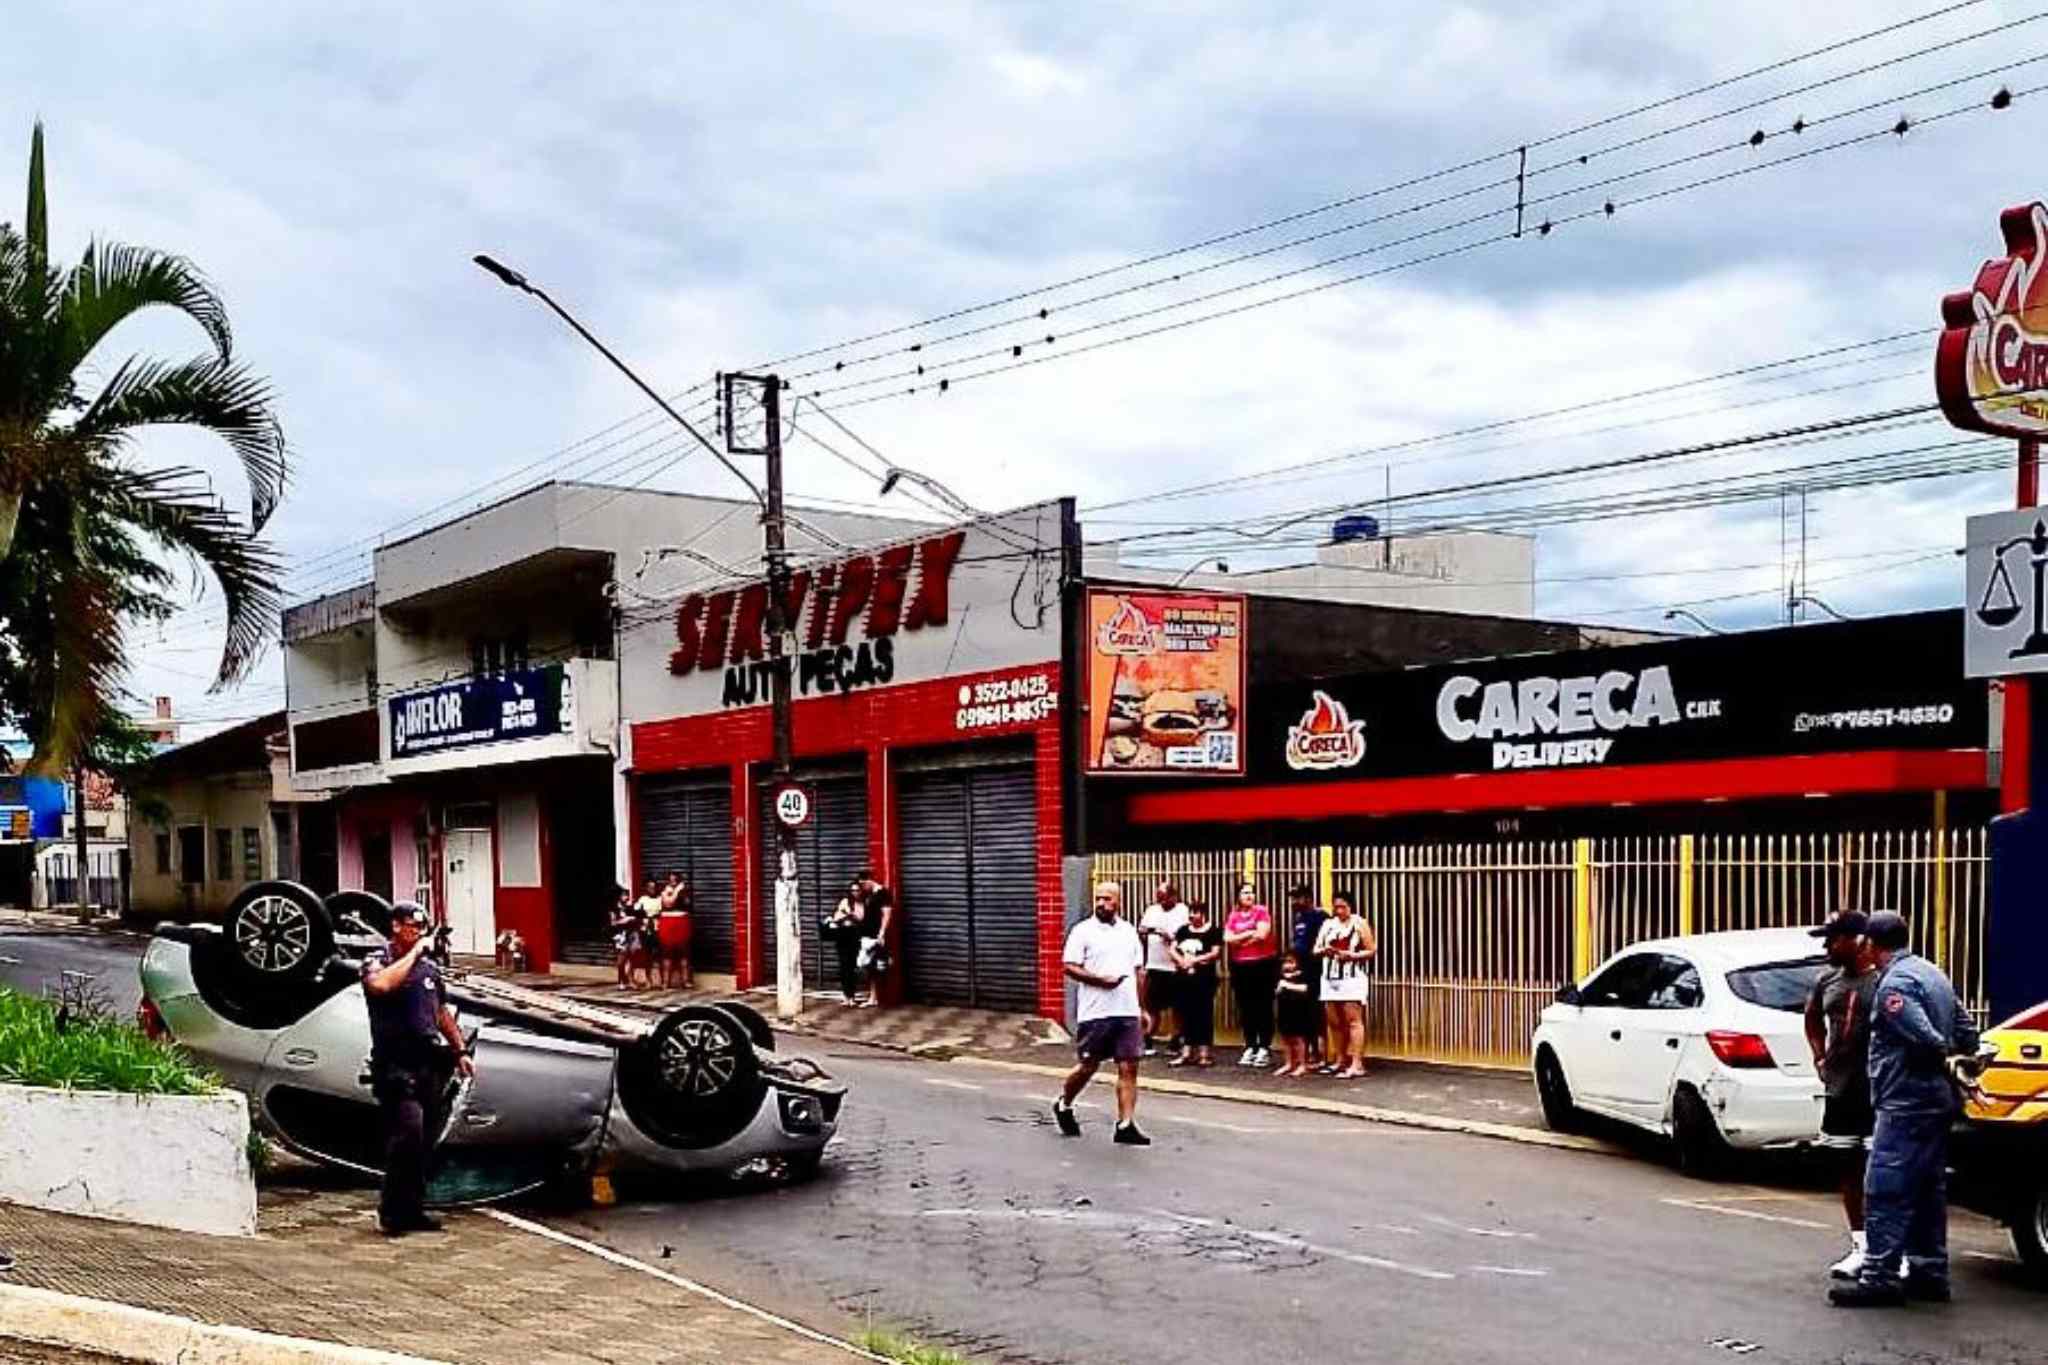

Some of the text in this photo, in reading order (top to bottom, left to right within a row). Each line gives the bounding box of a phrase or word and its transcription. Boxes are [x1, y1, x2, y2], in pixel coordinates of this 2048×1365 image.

[721, 656, 788, 707] AUT
[1436, 665, 1681, 742] CARECA
[1492, 737, 1615, 771] DELIVERY
[782, 793, 801, 811] 40
